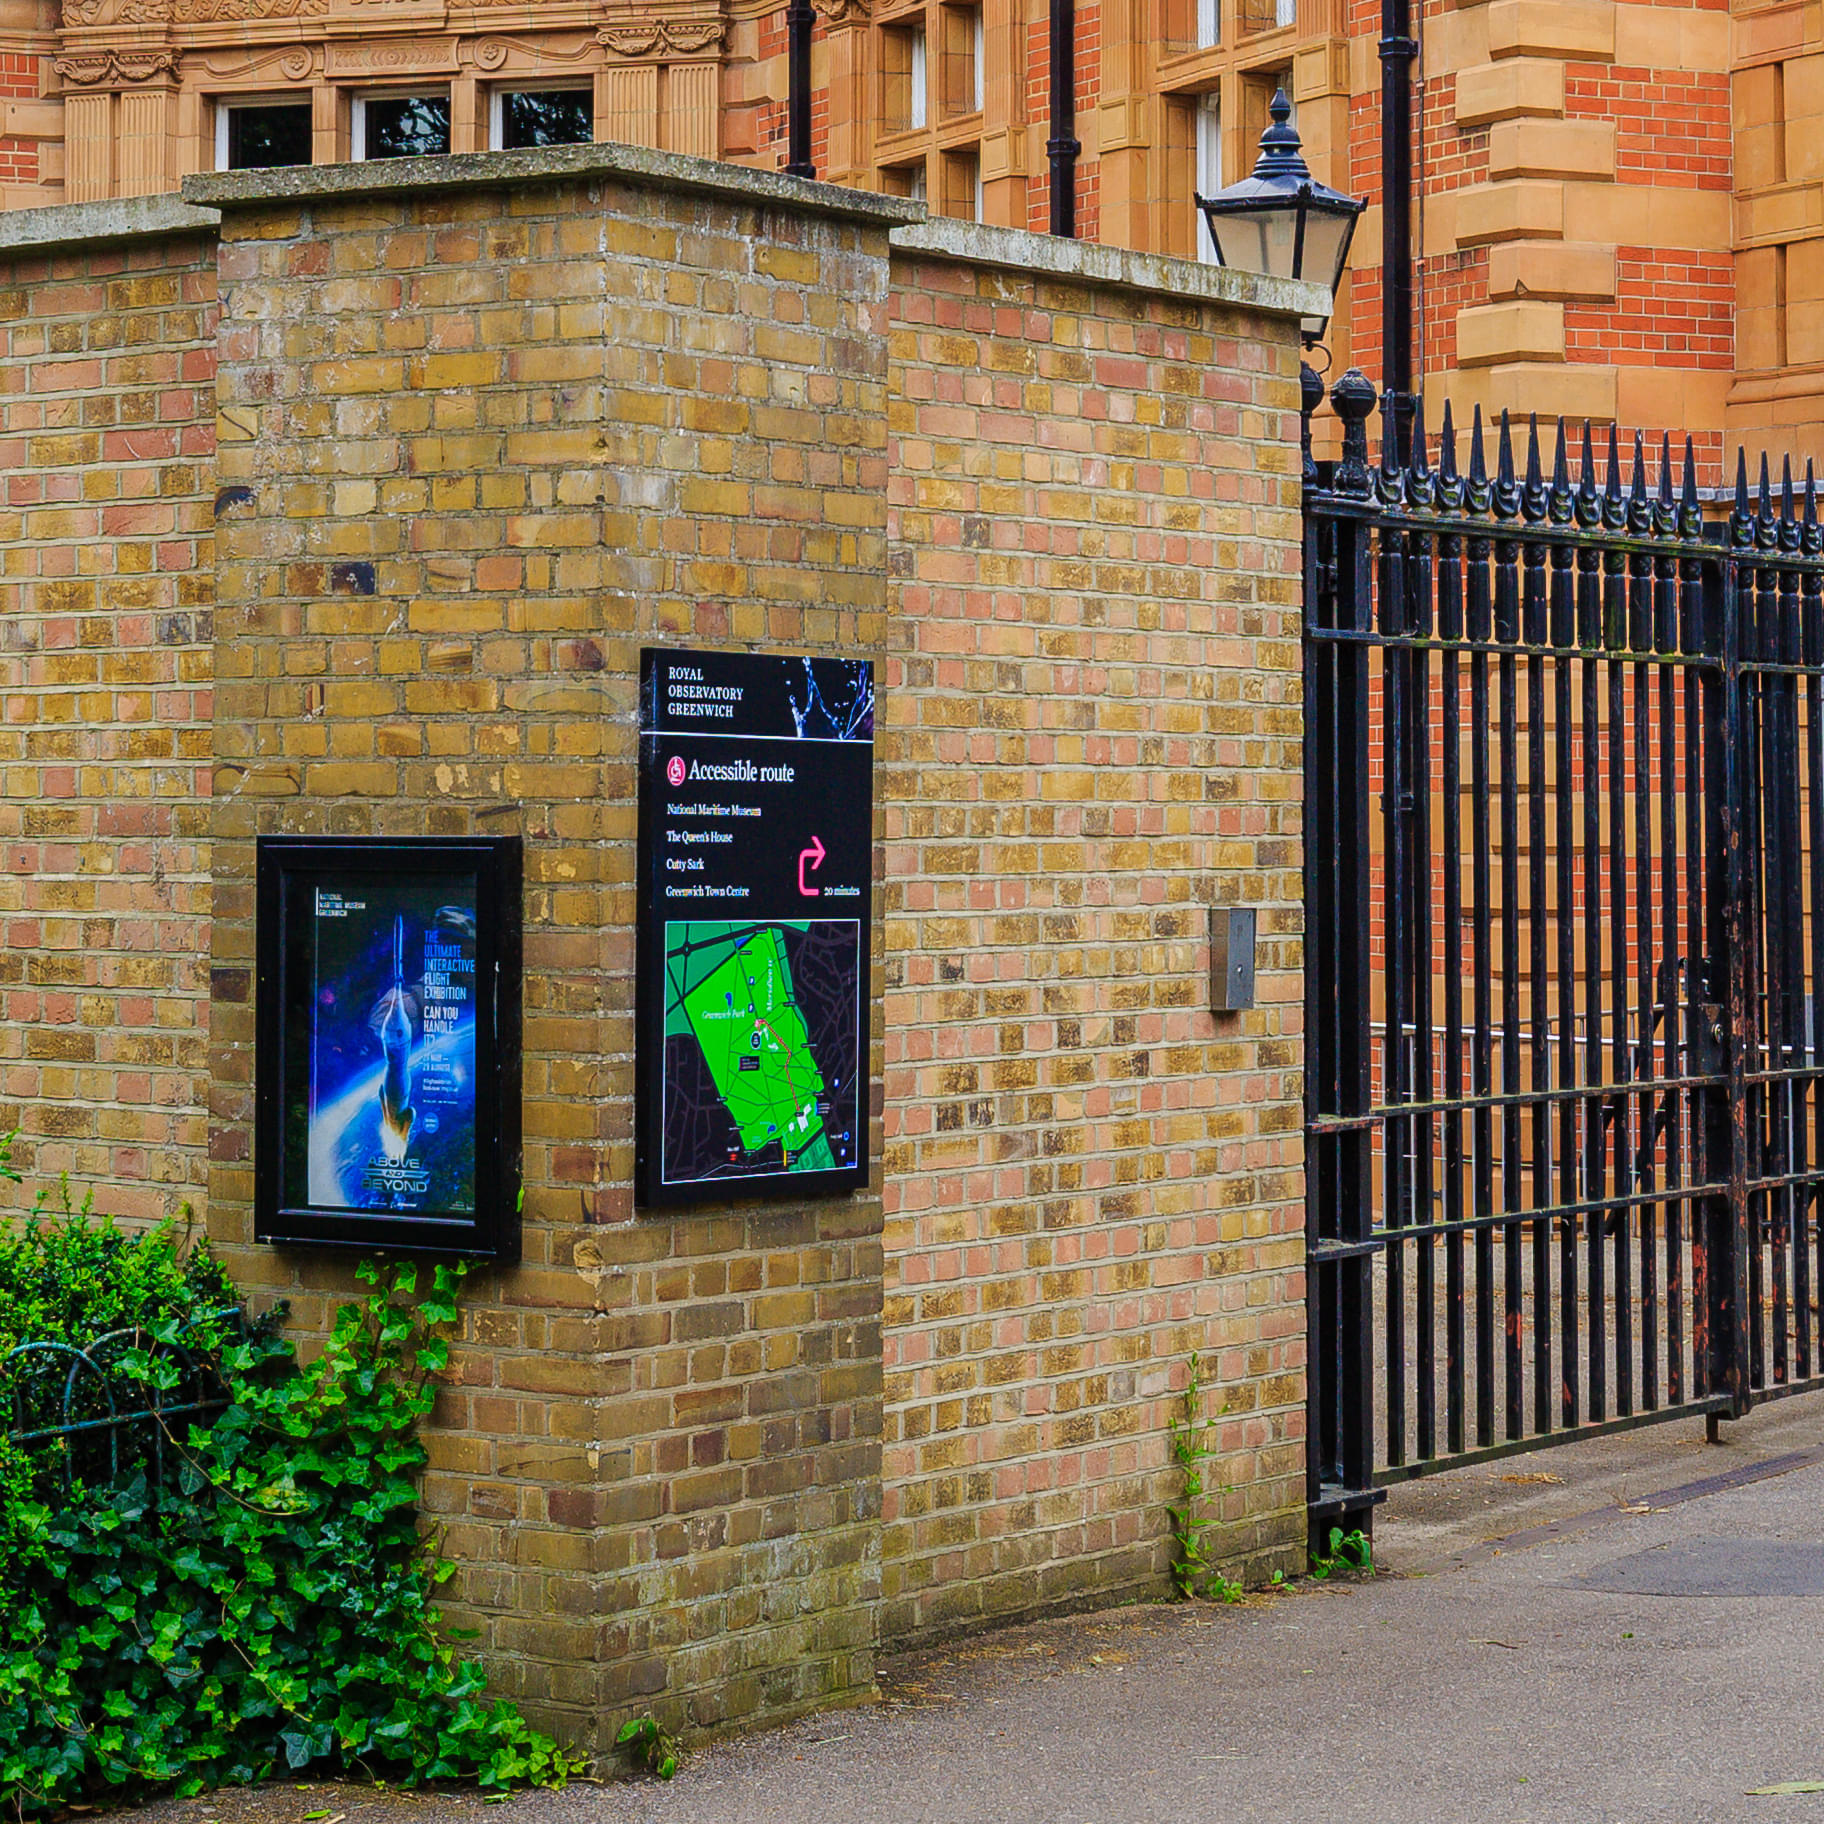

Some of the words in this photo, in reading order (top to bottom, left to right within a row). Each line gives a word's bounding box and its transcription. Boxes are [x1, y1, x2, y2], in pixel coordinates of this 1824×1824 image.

[668, 667, 704, 681] ROYAL
[668, 684, 744, 701] OBSERVATORY
[667, 703, 734, 718] GREENWICH
[688, 759, 758, 782] Accessible
[760, 763, 794, 782] route
[667, 804, 697, 816] National
[698, 804, 730, 816] Maritime
[732, 805, 761, 817] Museum
[666, 830, 681, 844] The
[682, 831, 709, 845] Queen's
[711, 832, 733, 844] House
[666, 858, 686, 873] Cutty
[687, 858, 704, 871] Sark
[666, 885, 704, 897] Greenwich
[705, 885, 725, 897] Town
[726, 886, 750, 897] Centre
[824, 886, 833, 896] 20
[834, 885, 860, 896] minutes
[424, 930, 439, 944] THE
[424, 944, 461, 958] ULTIMATE
[424, 958, 475, 973] INTERACTIVE
[424, 972, 451, 986] FLIGHT
[424, 986, 467, 1000] EXHIBITION
[423, 1006, 441, 1019] CAN
[443, 1007, 459, 1020] YOU
[423, 1019, 454, 1033] HANDLE
[368, 1156, 421, 1169] ABOVE
[361, 1177, 428, 1193] BEYOND
